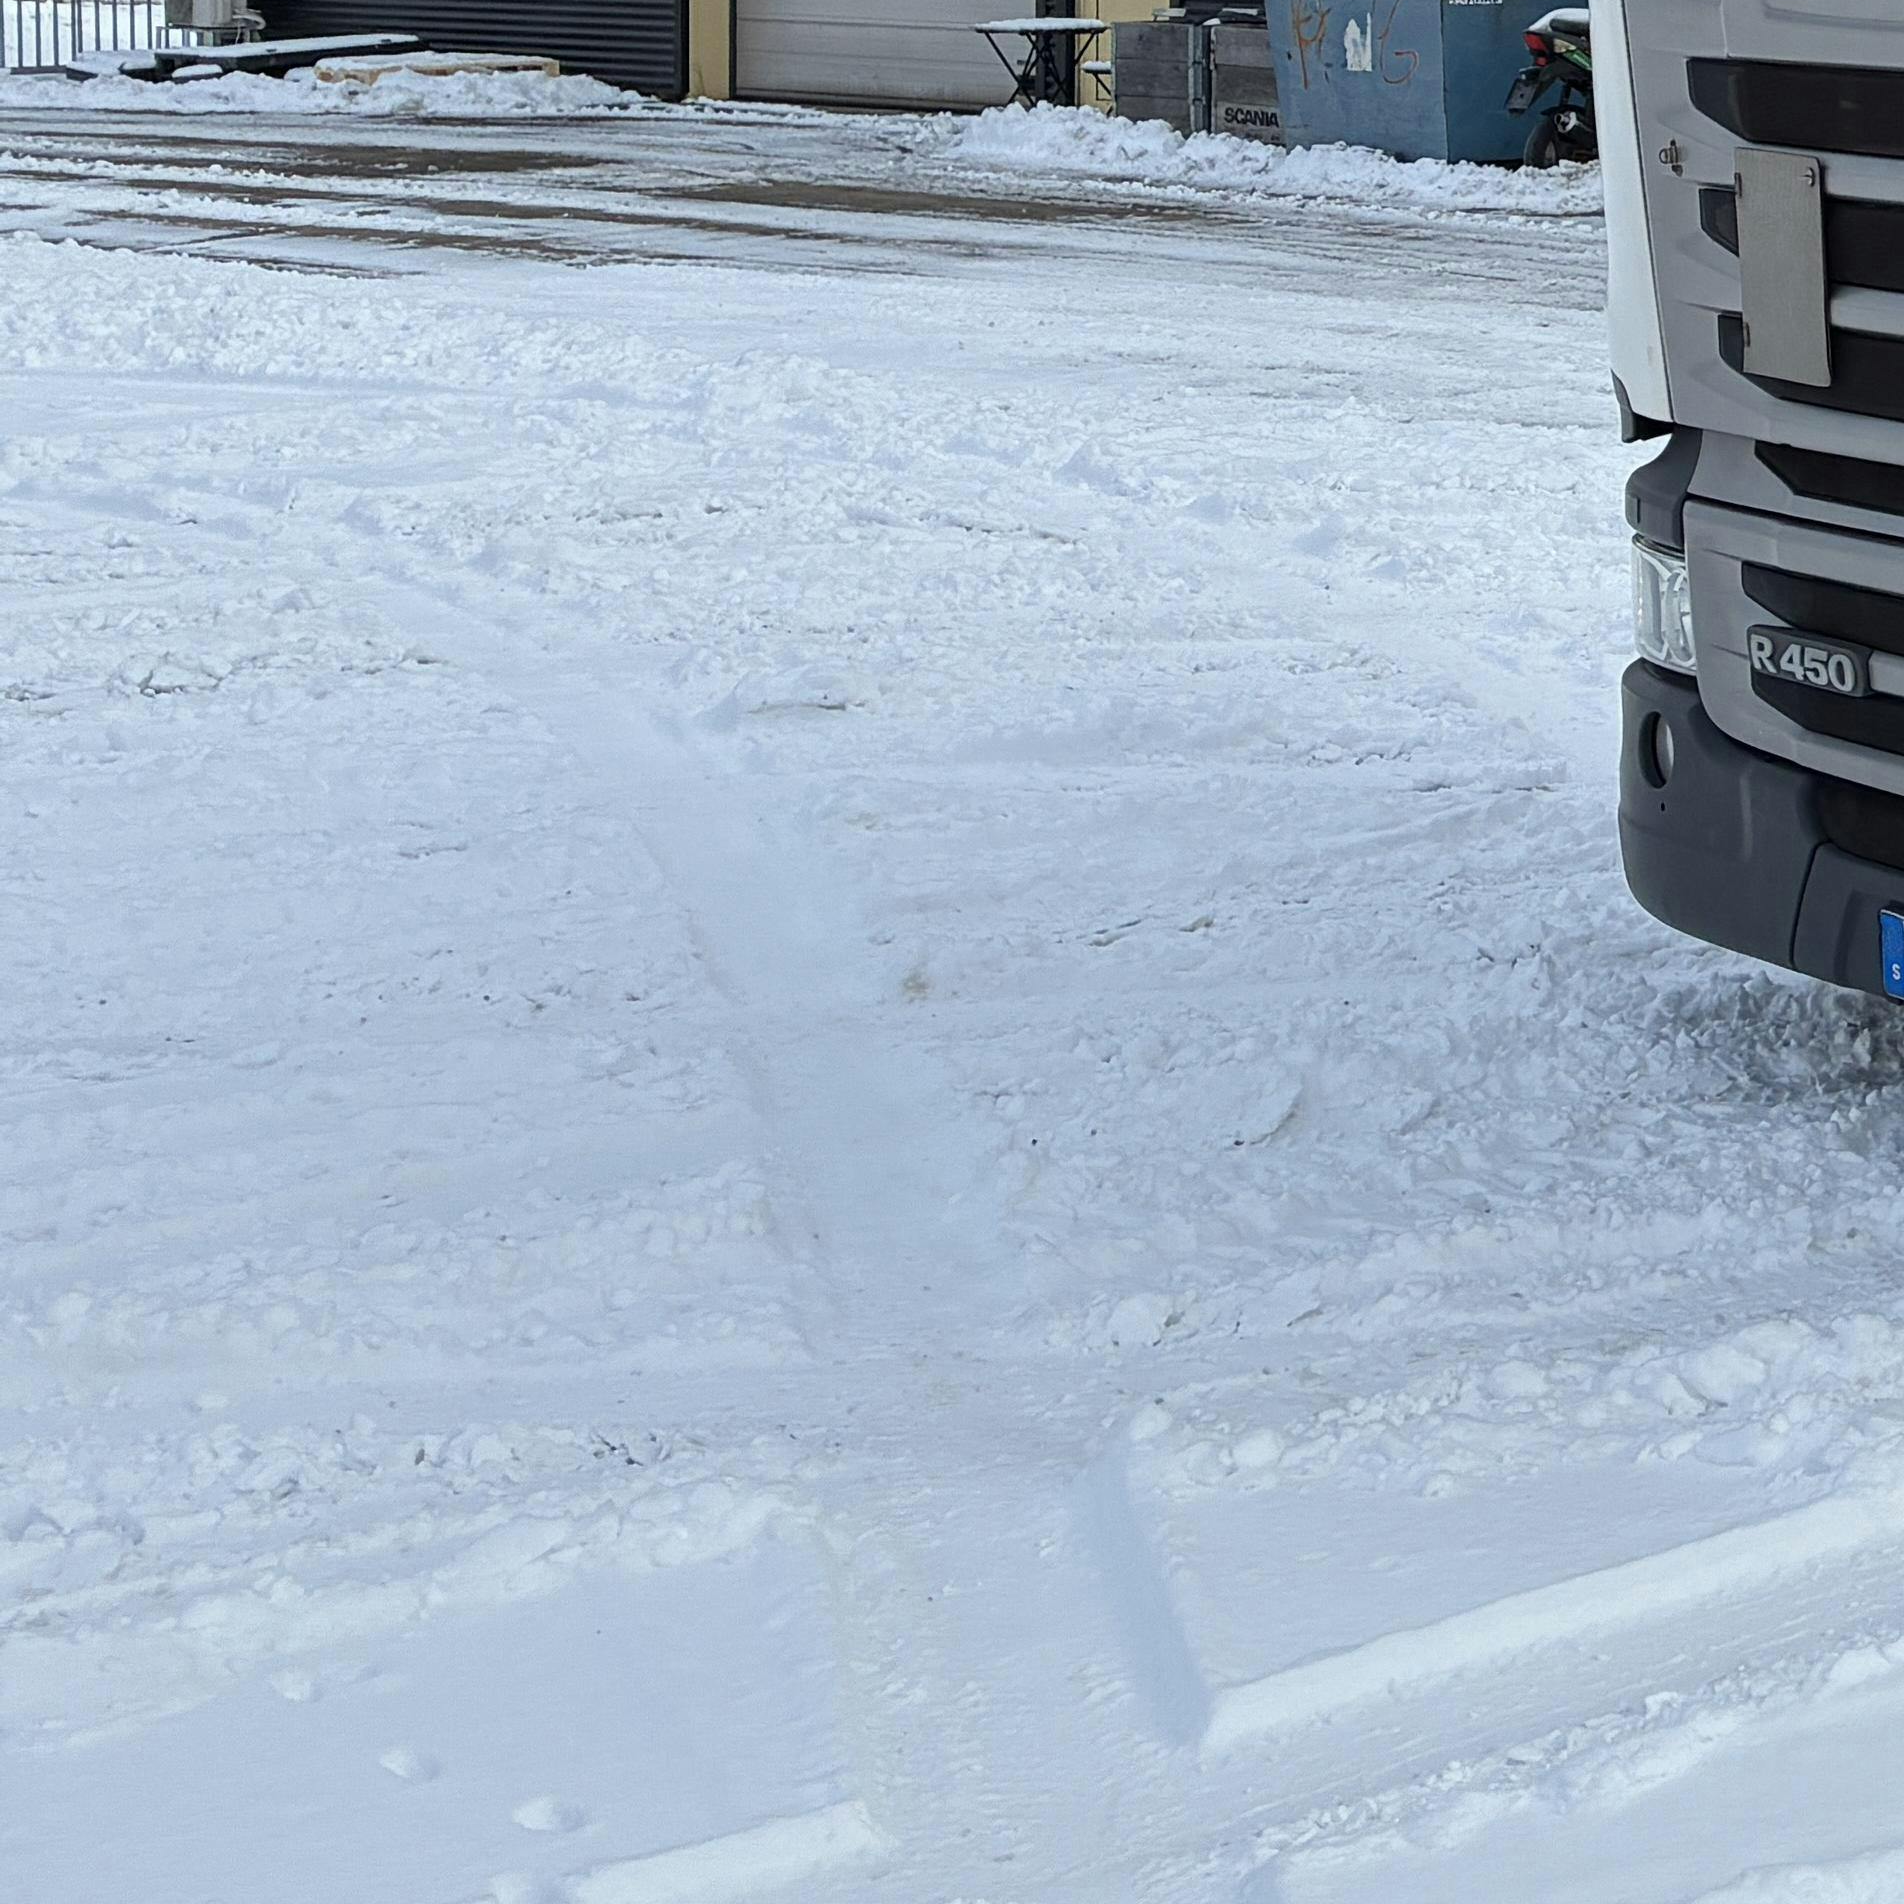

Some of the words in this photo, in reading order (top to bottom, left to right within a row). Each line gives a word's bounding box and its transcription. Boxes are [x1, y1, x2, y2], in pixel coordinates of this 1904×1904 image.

[1224, 106, 1280, 128] SCANIA
[1750, 633, 1778, 674] R
[1780, 643, 1856, 693] 450
[1892, 963, 1901, 981] S
